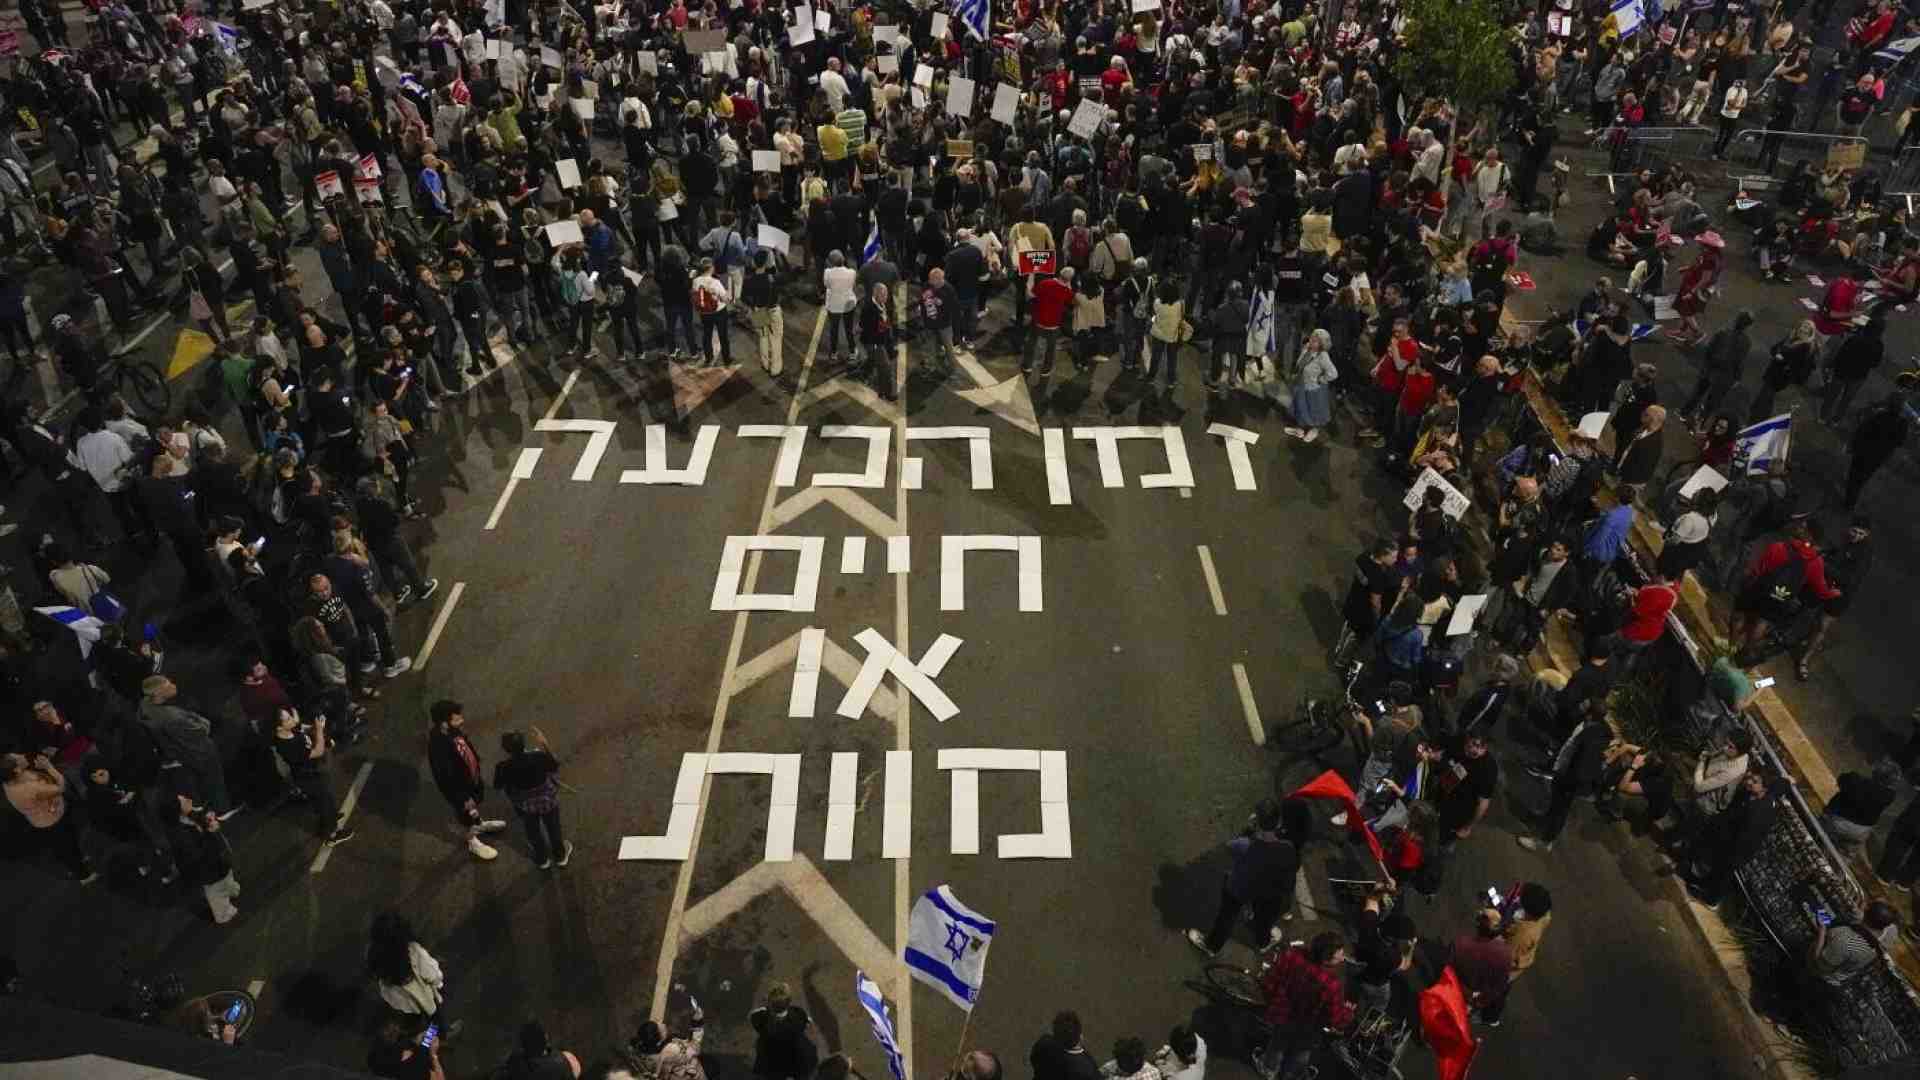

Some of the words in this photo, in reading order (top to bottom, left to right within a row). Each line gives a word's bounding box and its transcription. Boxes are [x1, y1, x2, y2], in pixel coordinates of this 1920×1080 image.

[511, 418, 994, 490] הכרעה
[1043, 423, 1260, 505] זמן
[710, 535, 1043, 613] חיים
[788, 627, 964, 721] או
[618, 747, 1073, 862] מוות
